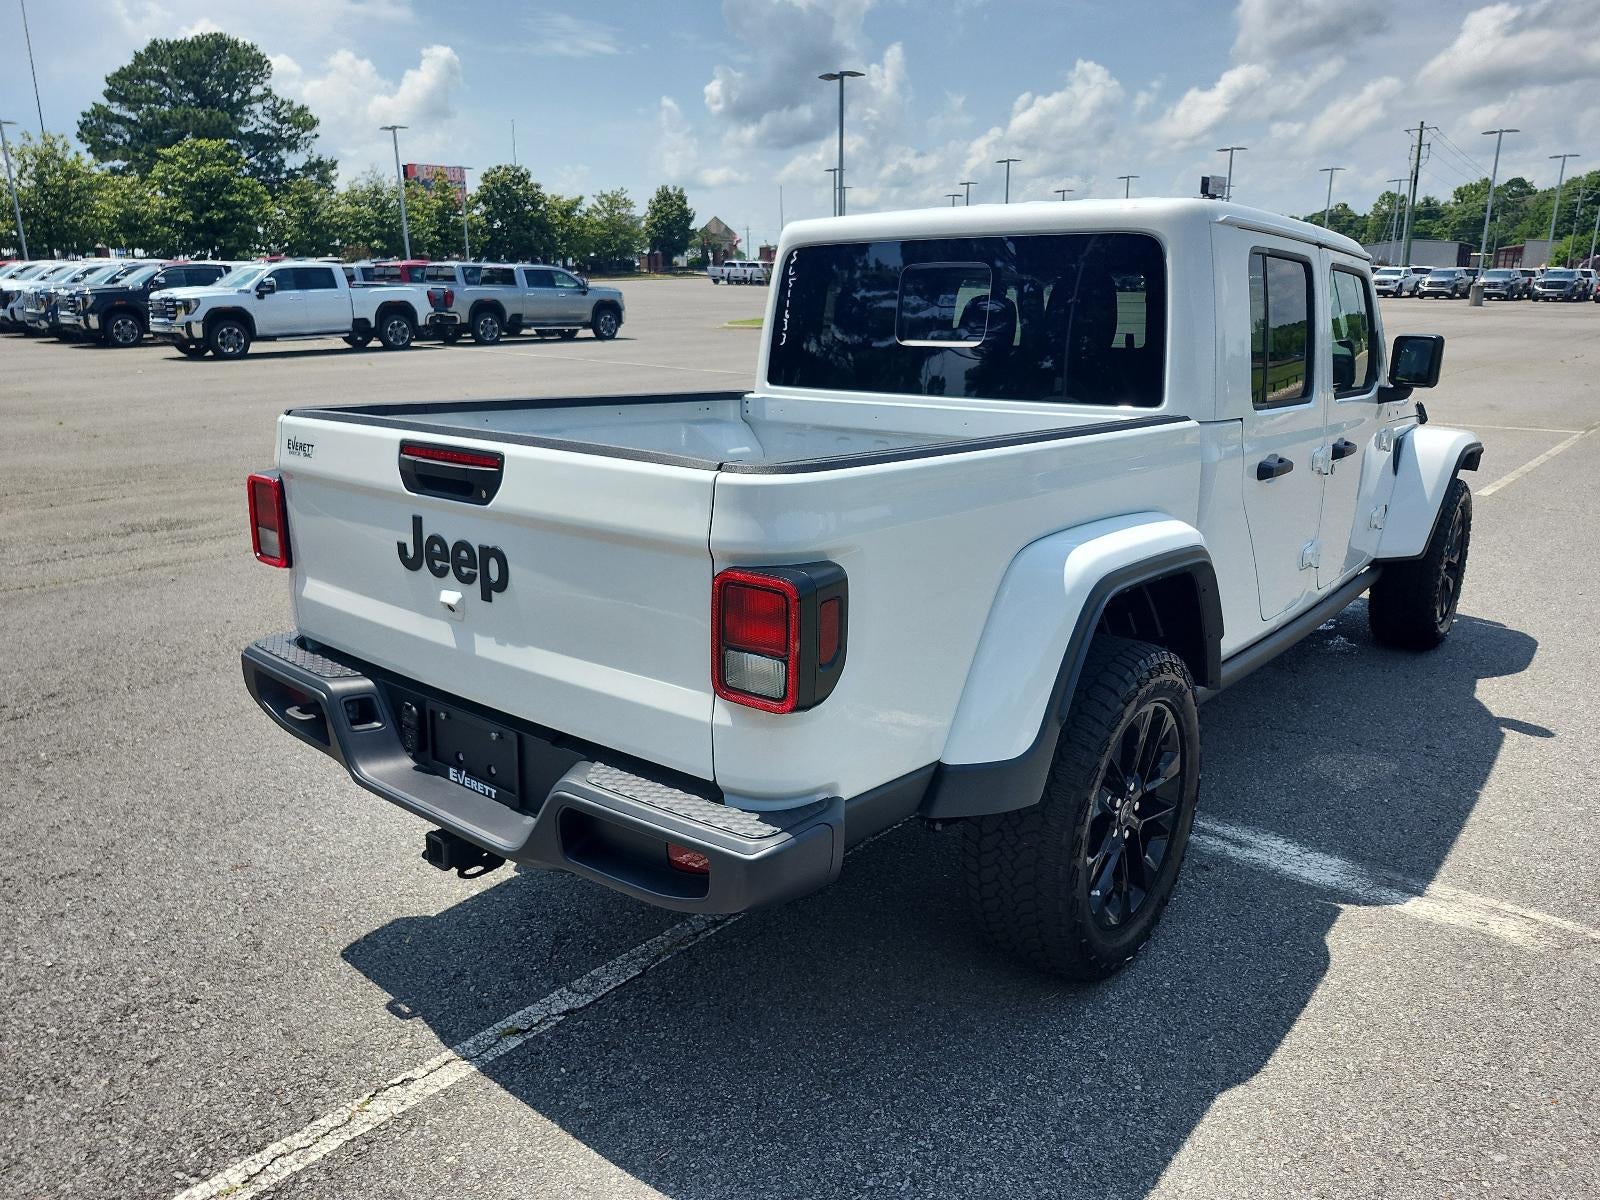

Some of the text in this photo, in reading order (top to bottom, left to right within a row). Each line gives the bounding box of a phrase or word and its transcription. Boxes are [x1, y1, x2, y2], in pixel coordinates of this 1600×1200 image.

[287, 435, 314, 453] EVERETT
[397, 514, 509, 603] Jeep
[449, 767, 497, 799] EVERETT
